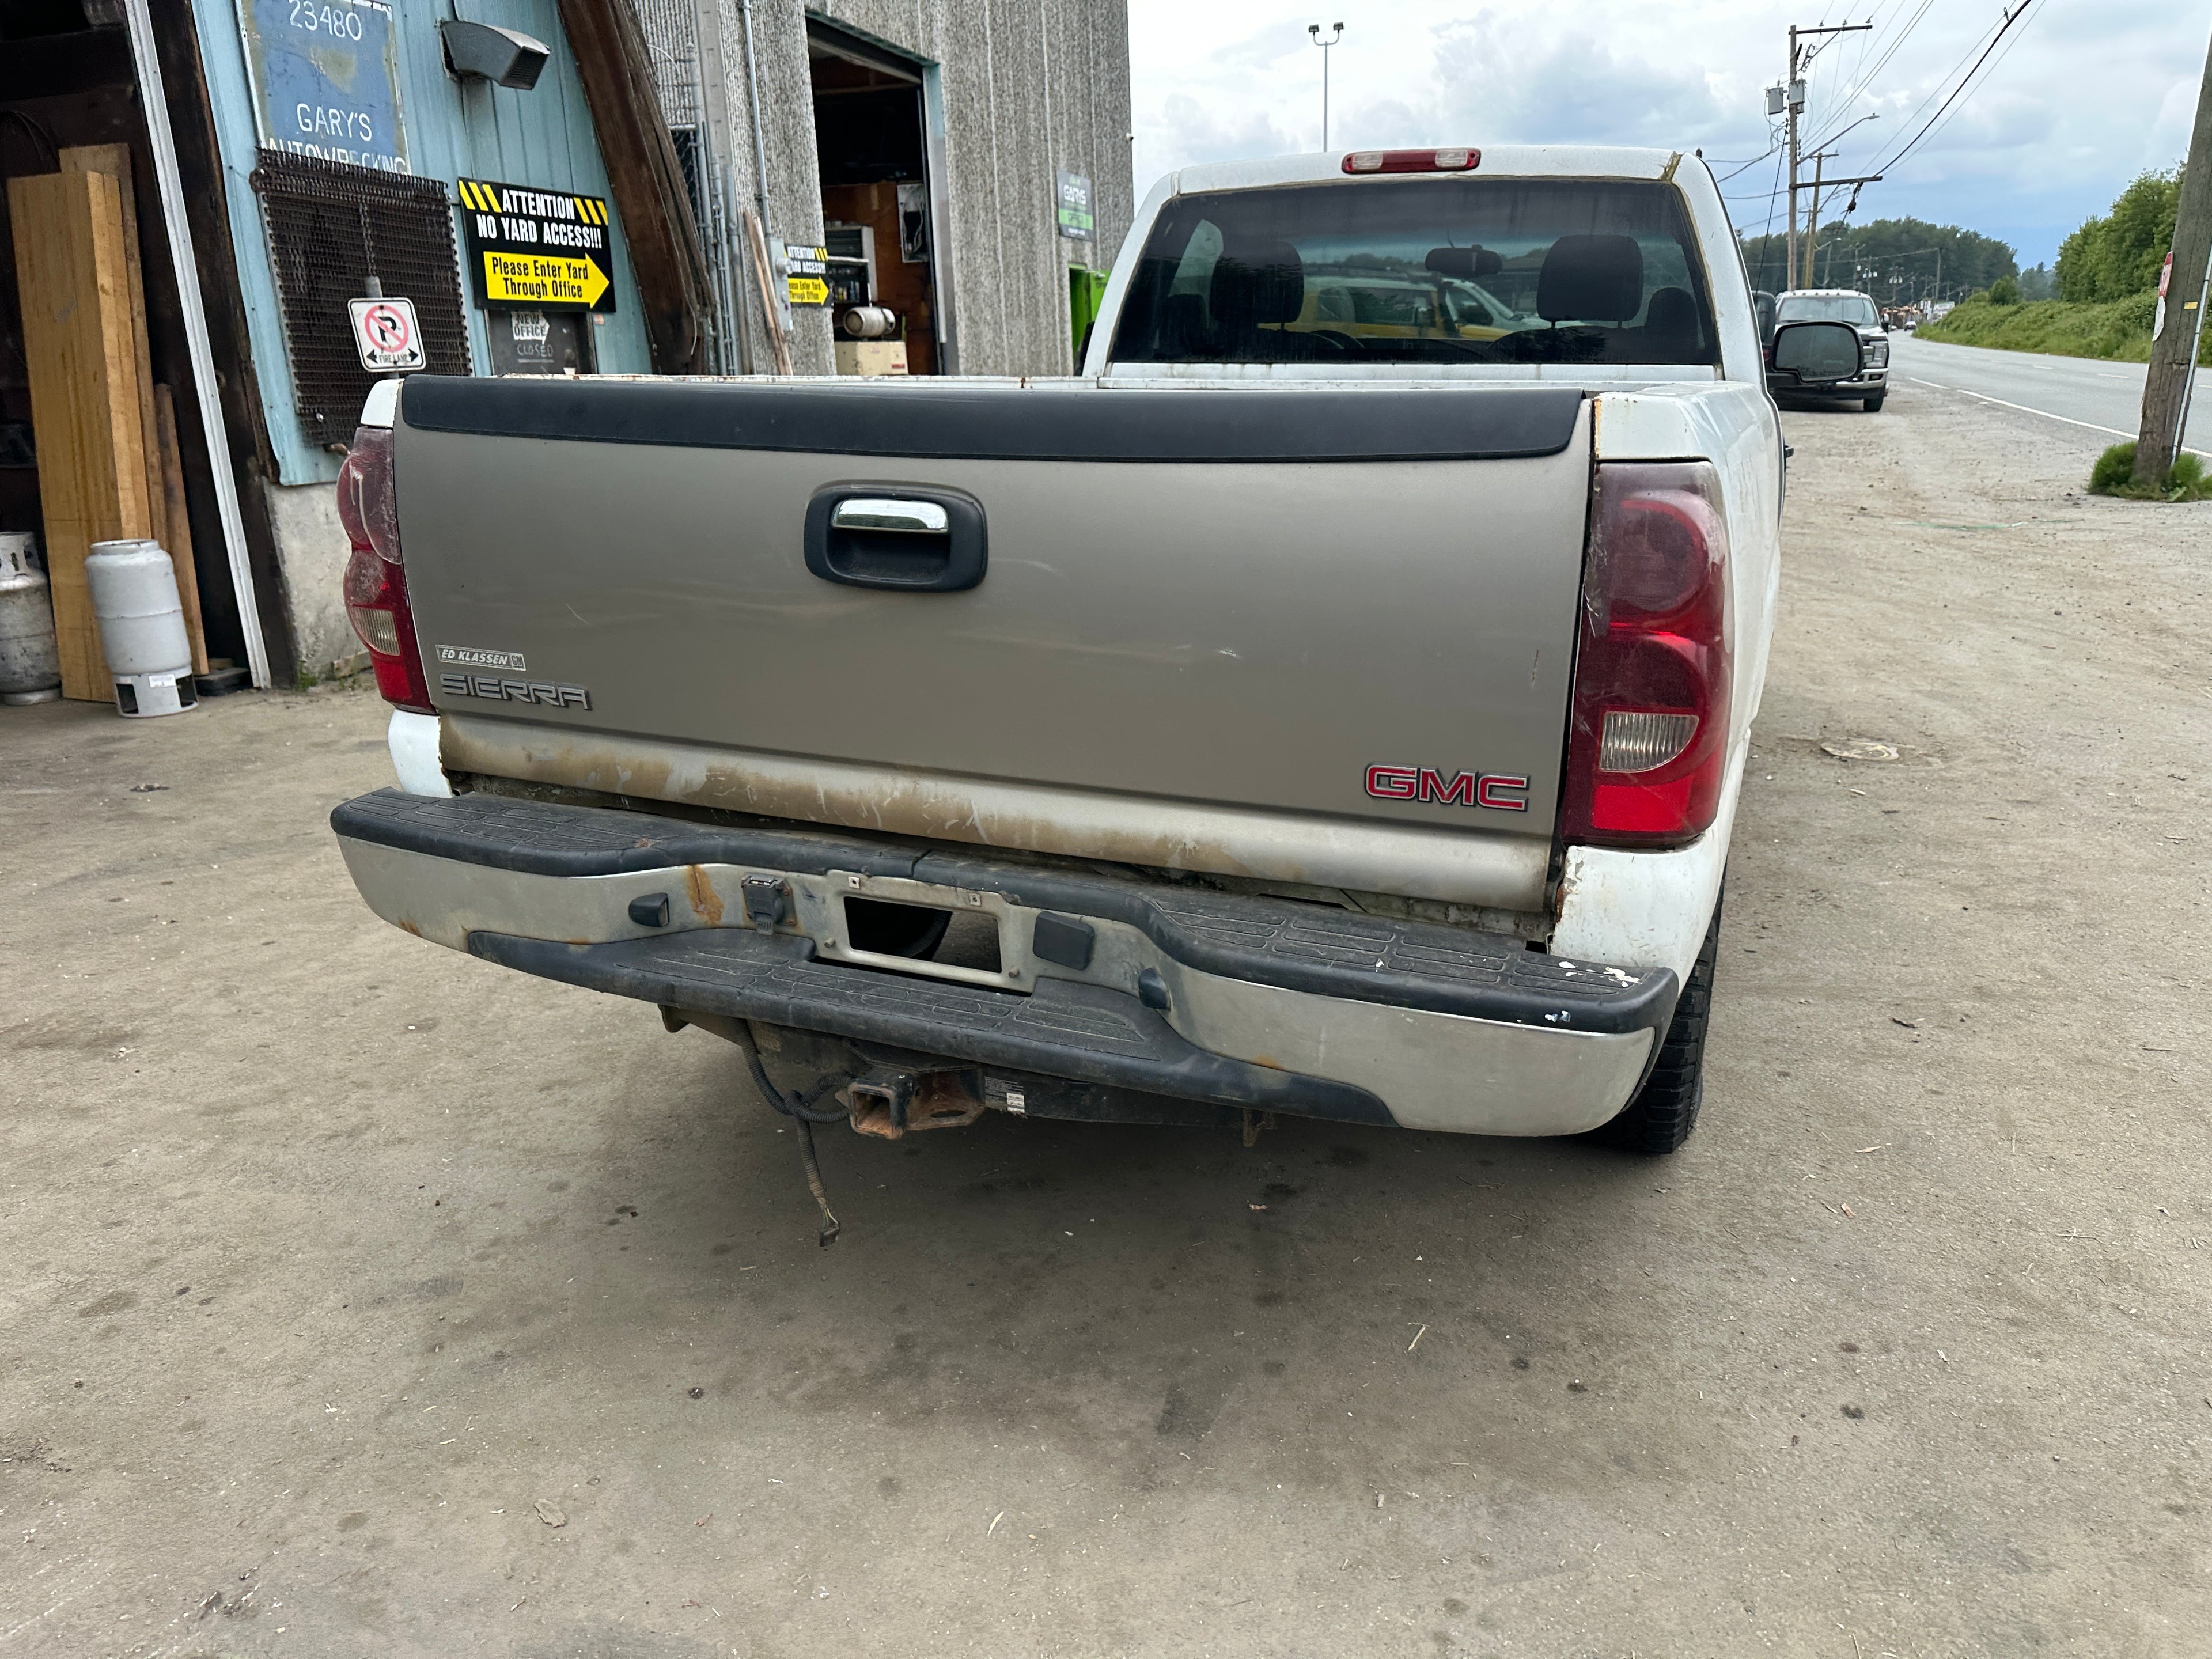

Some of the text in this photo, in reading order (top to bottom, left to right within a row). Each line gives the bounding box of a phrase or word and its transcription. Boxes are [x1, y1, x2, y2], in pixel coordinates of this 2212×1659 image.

[289, 0, 362, 41] 23480
[297, 103, 372, 142] GARY'S
[502, 189, 575, 220] ATTENTION
[476, 214, 602, 249] NO YARD ACCESS!!!
[787, 246, 815, 259] ATTENTION
[492, 257, 588, 279] Please Enter Yard
[790, 260, 802, 273] ARD
[503, 278, 582, 299] Through Office
[800, 281, 810, 290] Enter
[812, 281, 821, 290] Yard
[806, 291, 819, 300] Office
[519, 312, 539, 324] NEW
[514, 324, 546, 337] OFFICE
[379, 354, 392, 363] FIRE
[517, 344, 554, 358] CLOSED
[441, 649, 456, 659] ED
[458, 651, 508, 665] KLASSEN
[440, 673, 593, 711] SIERRA
[1364, 761, 1530, 812] GMC
